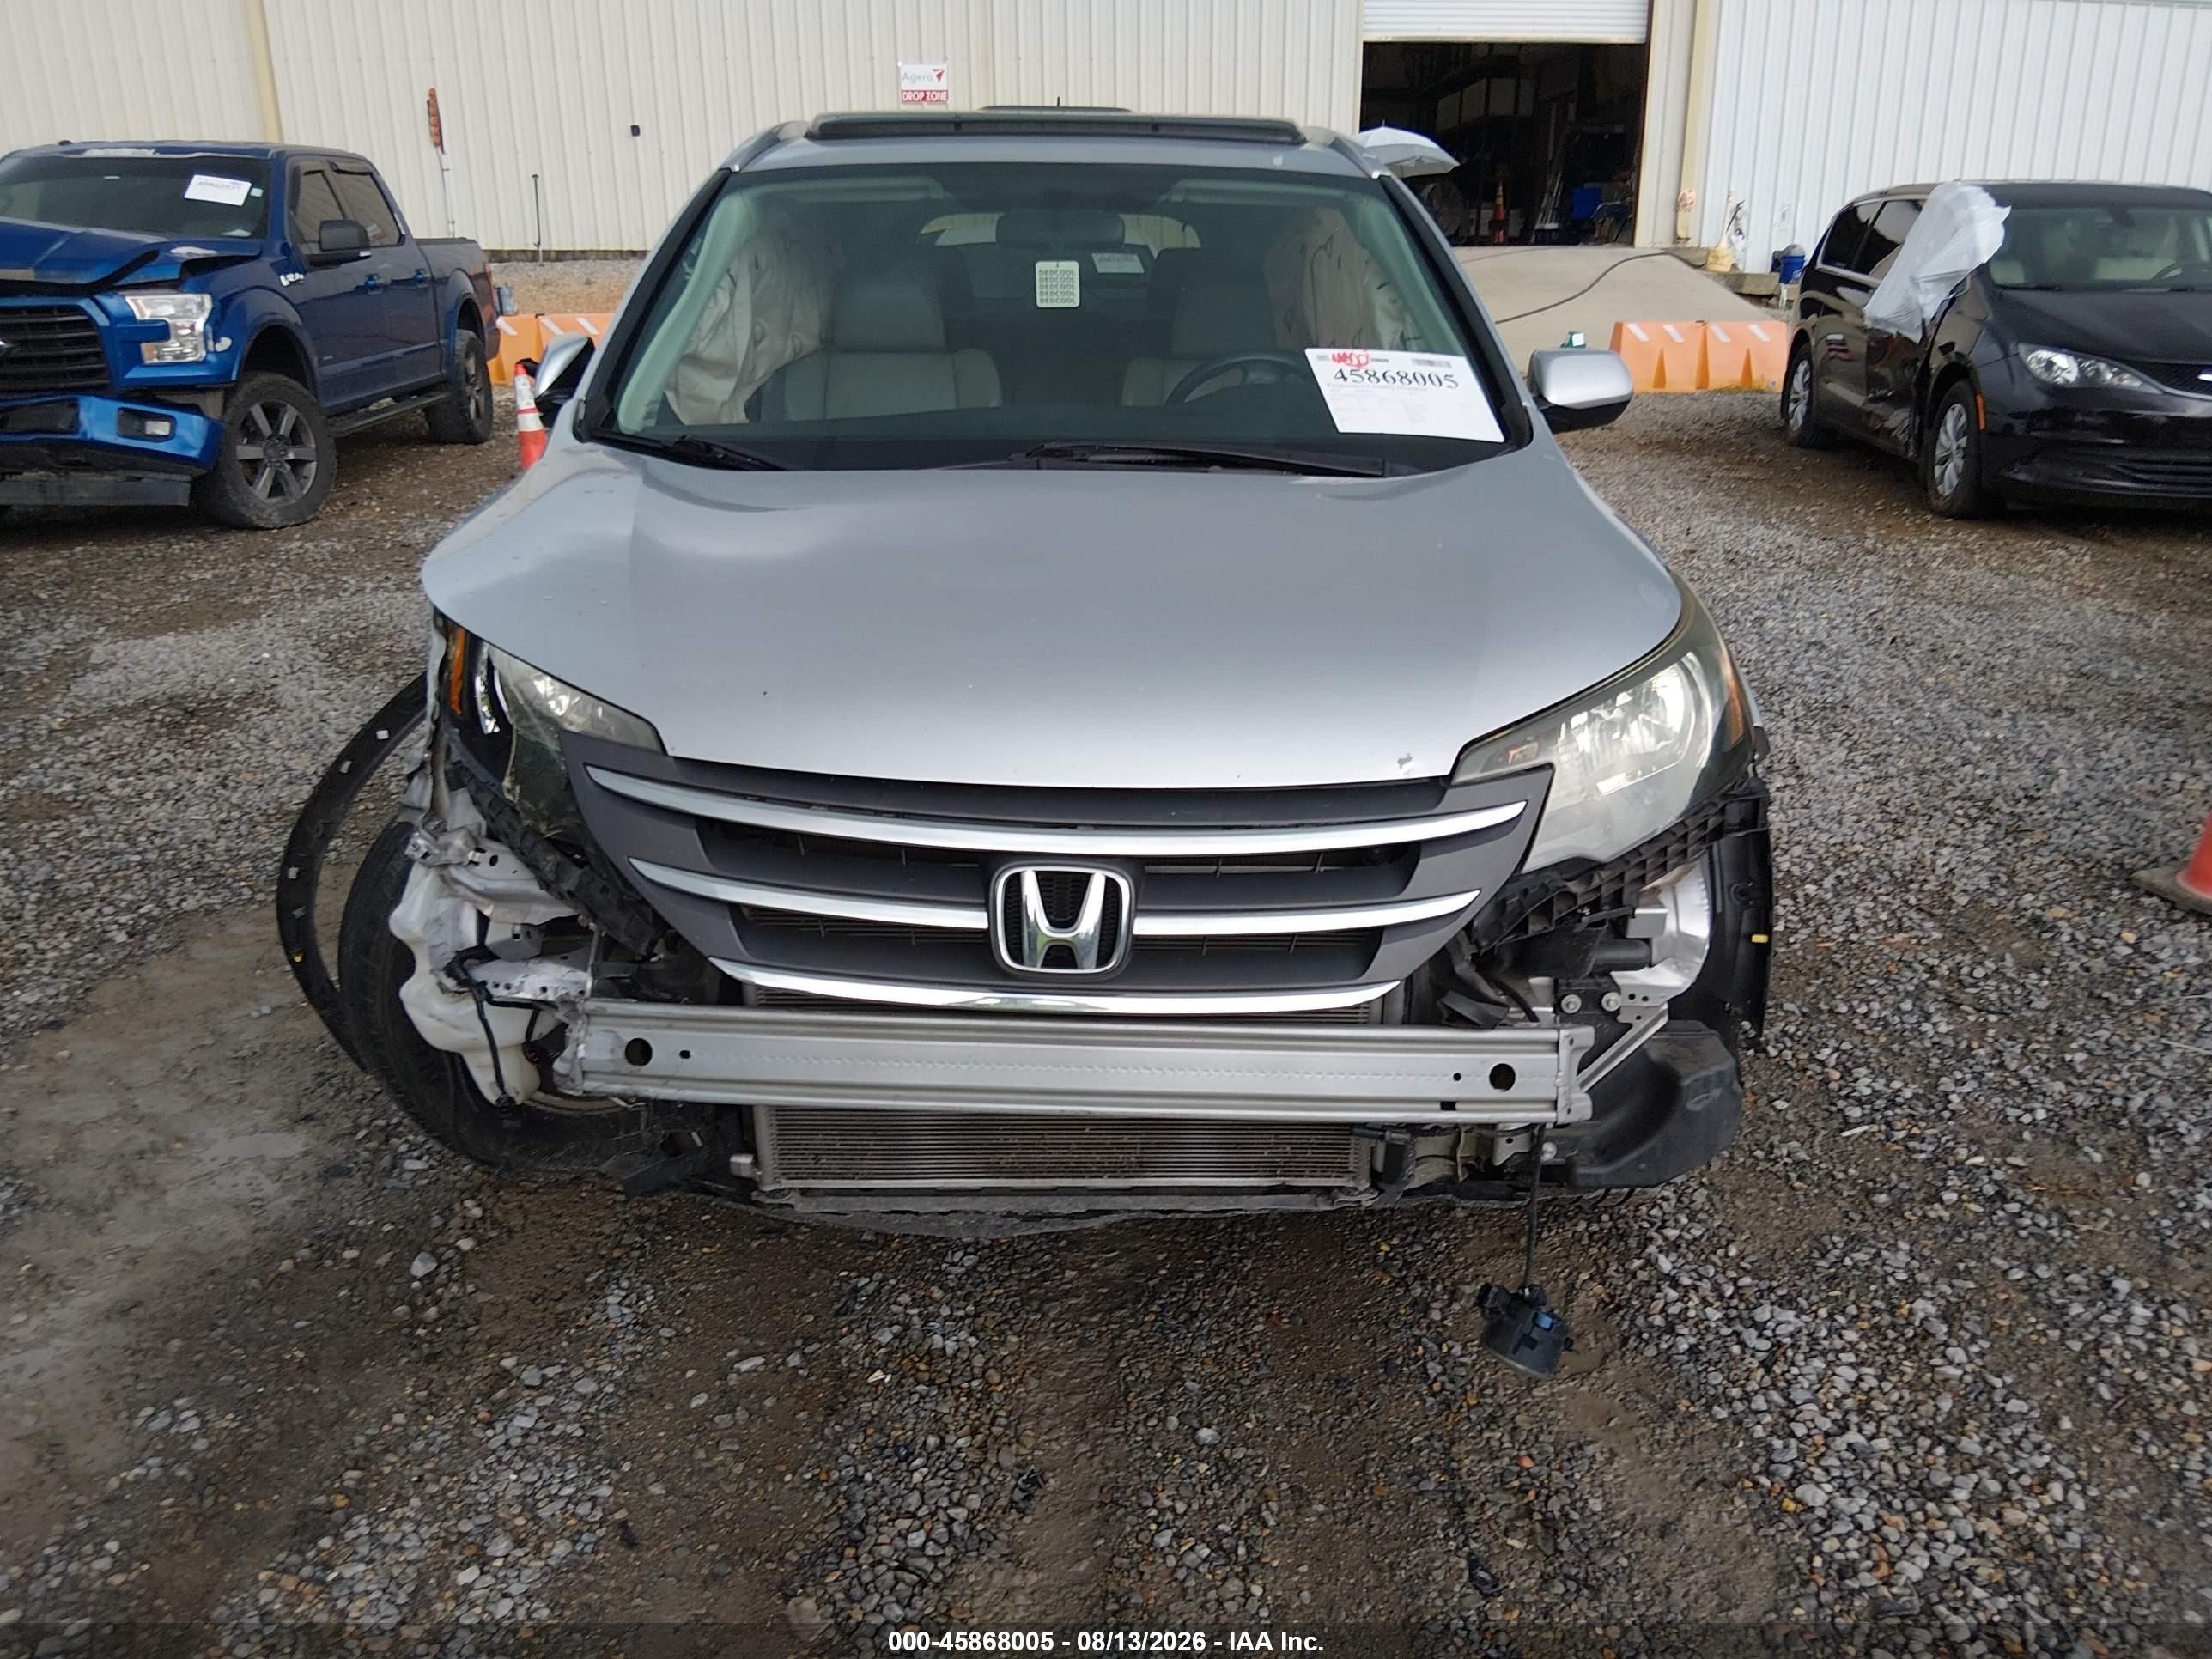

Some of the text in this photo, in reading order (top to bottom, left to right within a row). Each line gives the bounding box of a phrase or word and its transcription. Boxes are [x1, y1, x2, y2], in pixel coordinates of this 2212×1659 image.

[902, 71, 933, 84] Agero
[902, 91, 948, 101] DROP ZONE
[1334, 368, 1460, 389] 45868005
